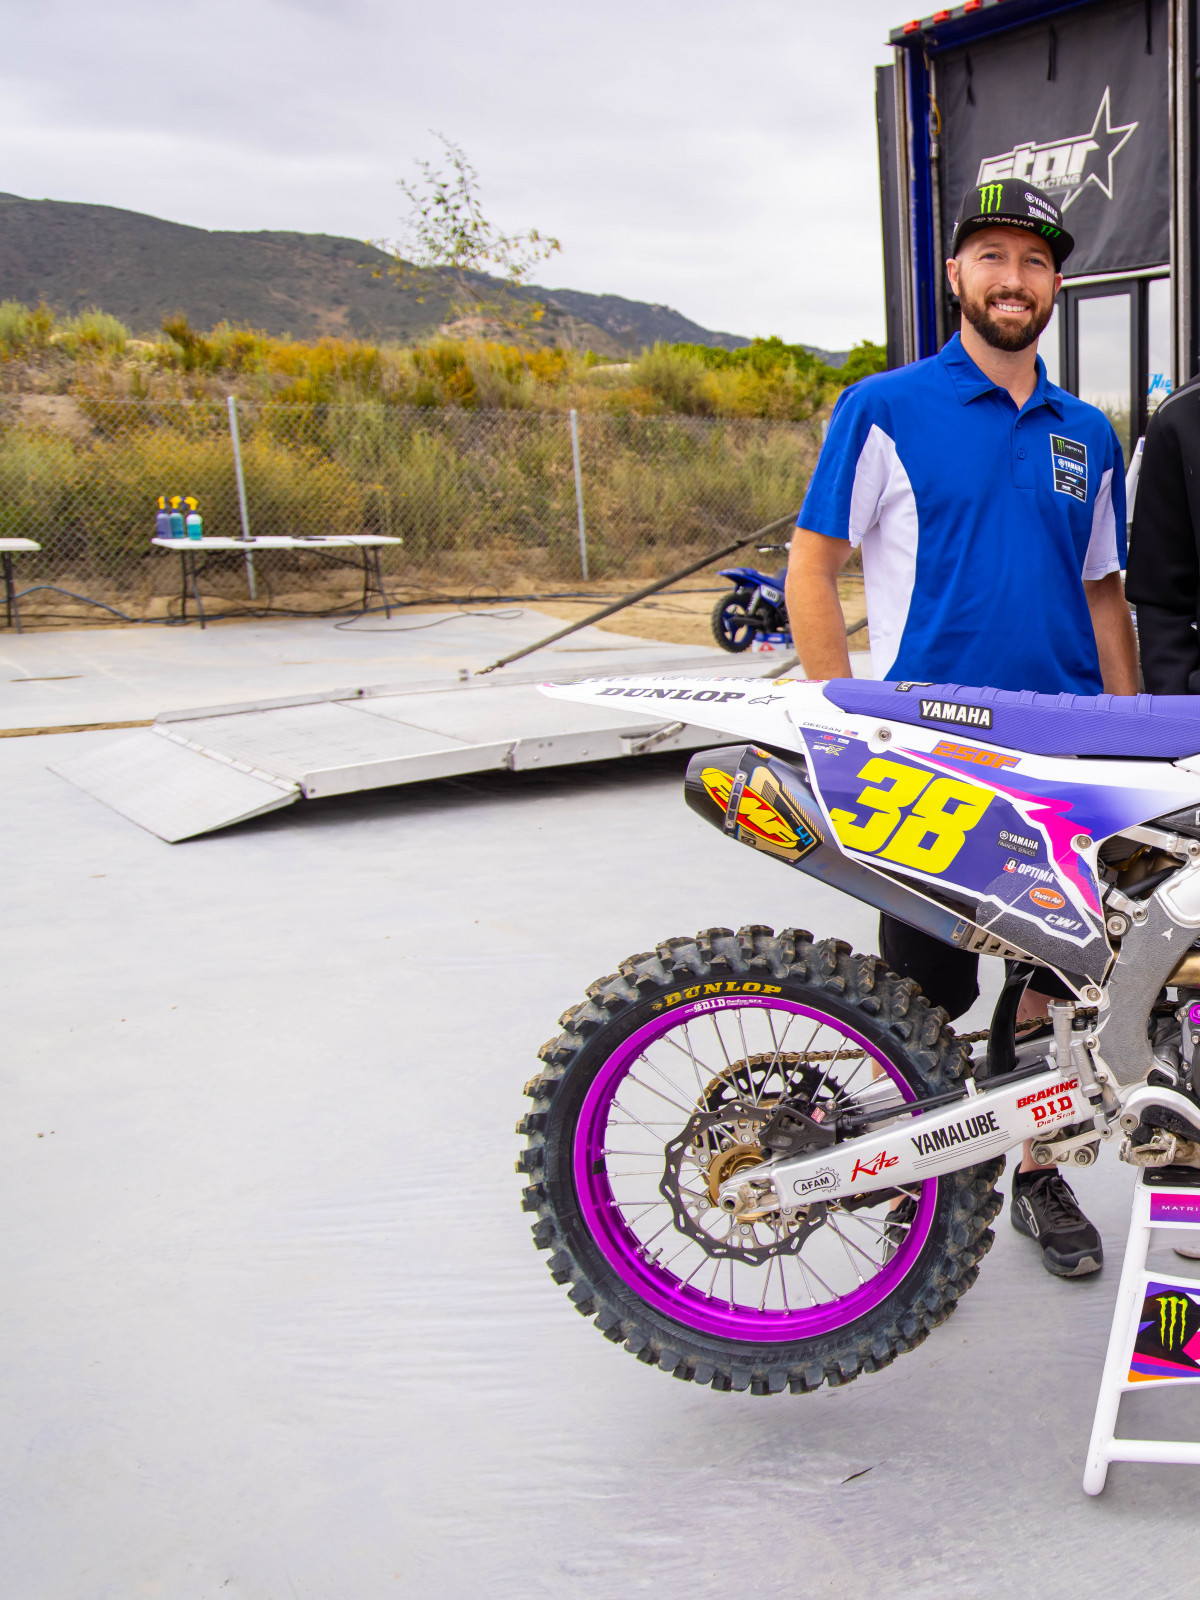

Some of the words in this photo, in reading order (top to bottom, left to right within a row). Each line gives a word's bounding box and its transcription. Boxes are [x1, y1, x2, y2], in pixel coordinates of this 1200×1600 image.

[1034, 196, 1059, 220] YAMAHA
[595, 687, 746, 703] DUNLOP
[922, 699, 991, 727] YAMAHA
[802, 721, 842, 733] DEEGAN
[930, 739, 1022, 769] 250F
[832, 757, 997, 874] 38
[1008, 832, 1040, 851] YAMAHA
[1017, 863, 1055, 884] OPTIMA
[1032, 890, 1051, 903] Twin
[1050, 895, 1063, 906] Air
[664, 981, 782, 1008] DUNLOP
[1016, 1078, 1079, 1109] BRAKING
[1030, 1095, 1074, 1122] D.I.D
[911, 1110, 1001, 1156] YAMALUBE
[850, 1150, 900, 1182] Kite
[800, 1176, 830, 1192] AFAM
